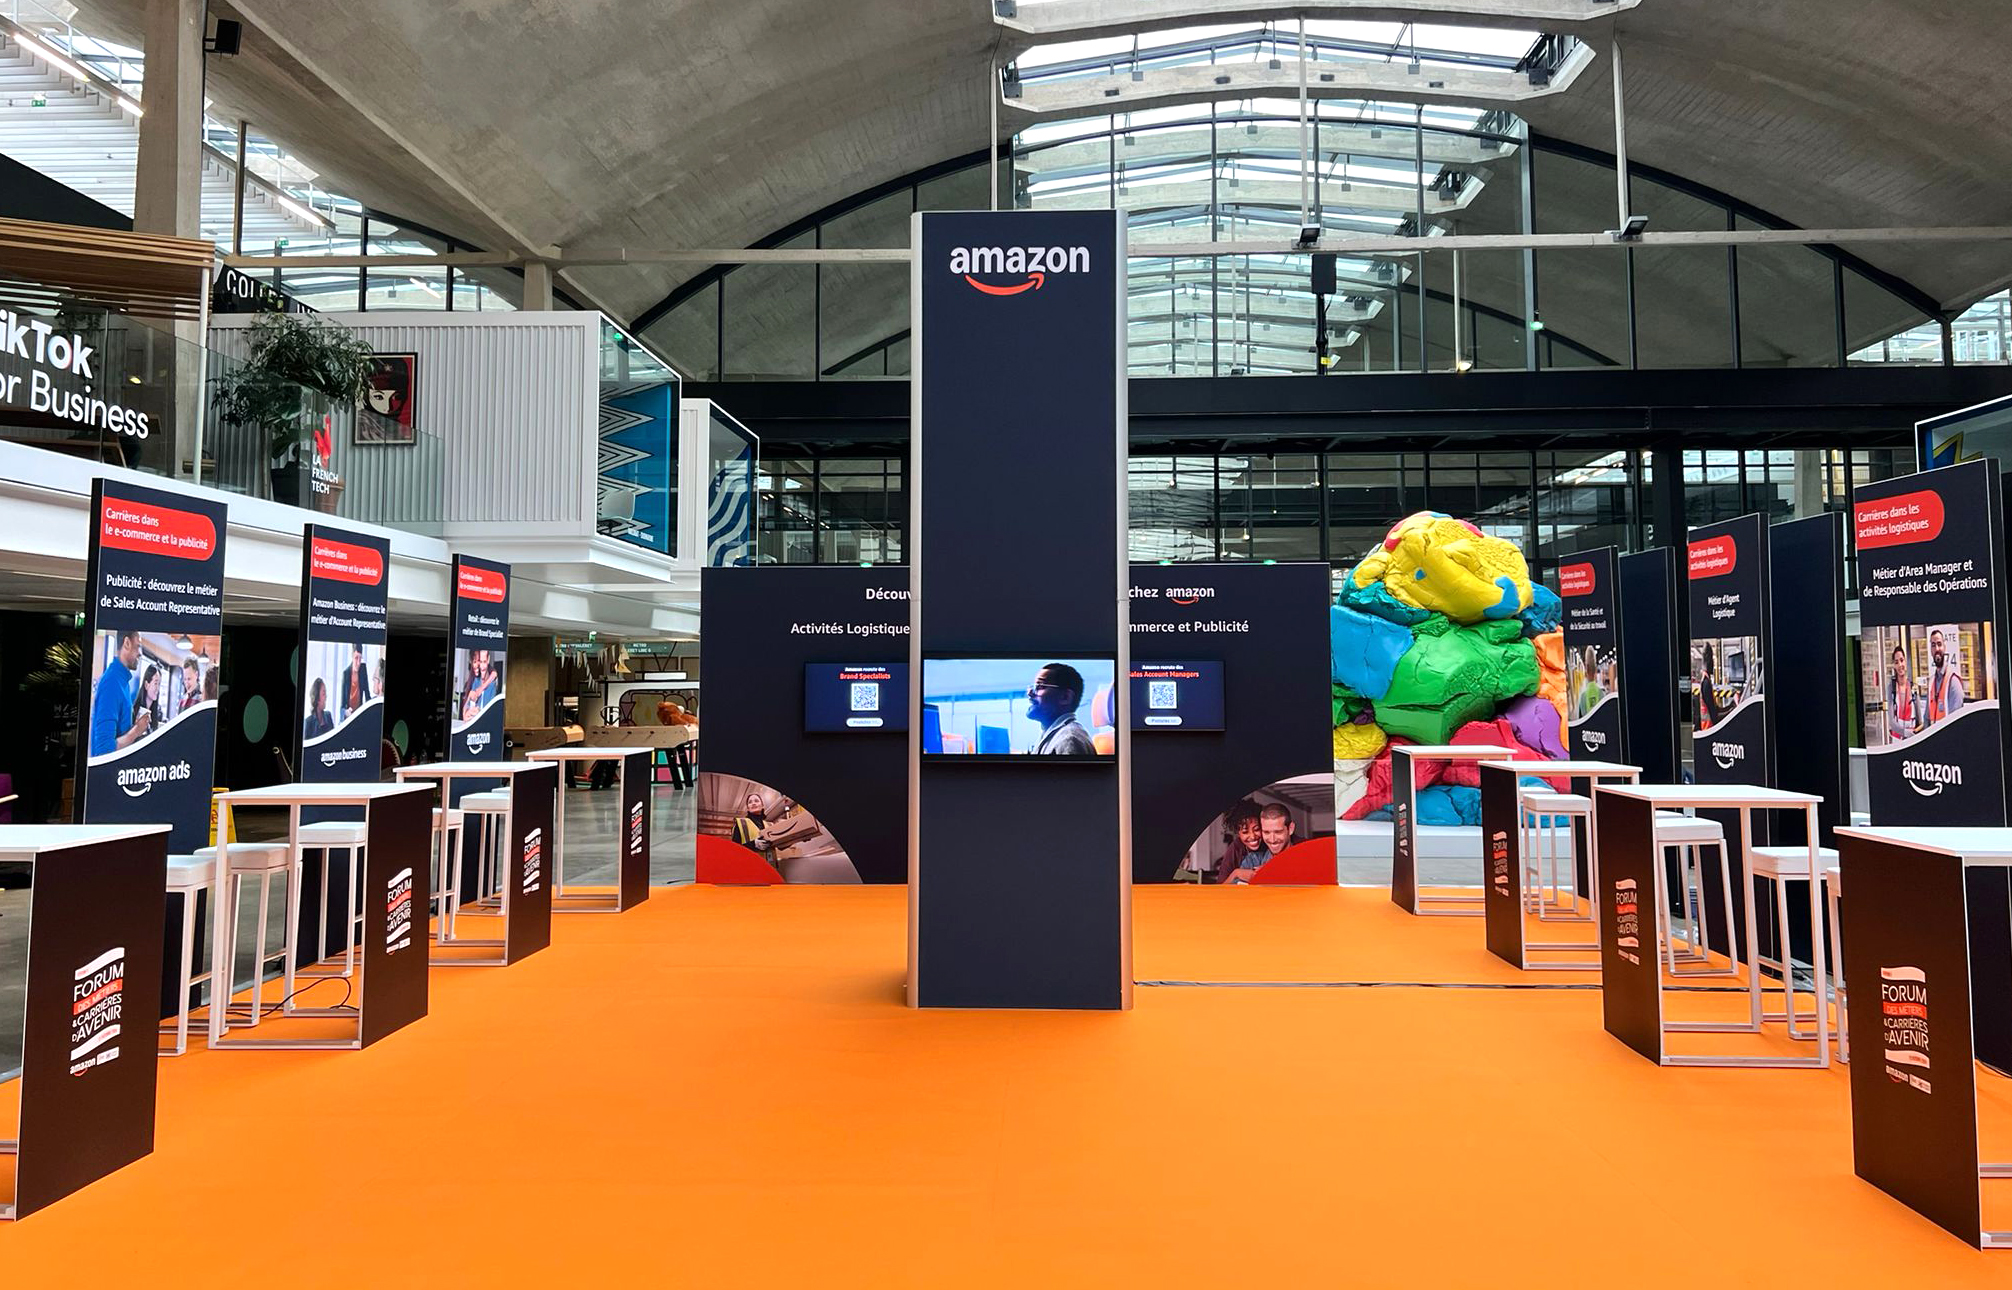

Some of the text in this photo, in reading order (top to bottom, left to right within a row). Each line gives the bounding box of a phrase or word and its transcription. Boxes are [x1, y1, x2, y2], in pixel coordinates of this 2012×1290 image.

[950, 246, 1090, 274] amazon
[0, 309, 94, 379] ikTok
[30, 369, 149, 440] Business
[312, 454, 322, 466] LA
[312, 467, 339, 484] FRENCH
[311, 480, 330, 494] TECH
[106, 508, 160, 526] Carrières dans
[1858, 504, 1920, 522] Carrières dans les
[105, 523, 208, 550] le e-commerce et la publicité
[1859, 520, 1929, 538] activités logistiques
[1872, 560, 1973, 580] Métier d'Area Manager et
[106, 574, 142, 589] Publicité
[148, 578, 185, 594] découvrez
[186, 582, 194, 594] le
[195, 584, 218, 596] métier
[866, 586, 1215, 600] Découv chez amazon
[1863, 576, 1987, 598] de Responsable des Opérations
[100, 594, 220, 616] de Sales Account Representative
[790, 623, 843, 634] Activités
[847, 623, 910, 636] Logistique
[1178, 622, 1190, 632] et
[1194, 620, 1249, 632] Publicité
[1944, 634, 1956, 642] ATE
[466, 732, 490, 745] amazon
[1582, 730, 1606, 744] amazon
[1712, 742, 1744, 759] amazon
[117, 760, 190, 785] amazon ads
[1902, 760, 1962, 785] amazon
[388, 878, 412, 903] FORUM
[1616, 891, 1637, 904] FORUM
[74, 962, 124, 1002] FORUM
[1882, 984, 1927, 1005] FORUM
[70, 1058, 96, 1074] amazon
